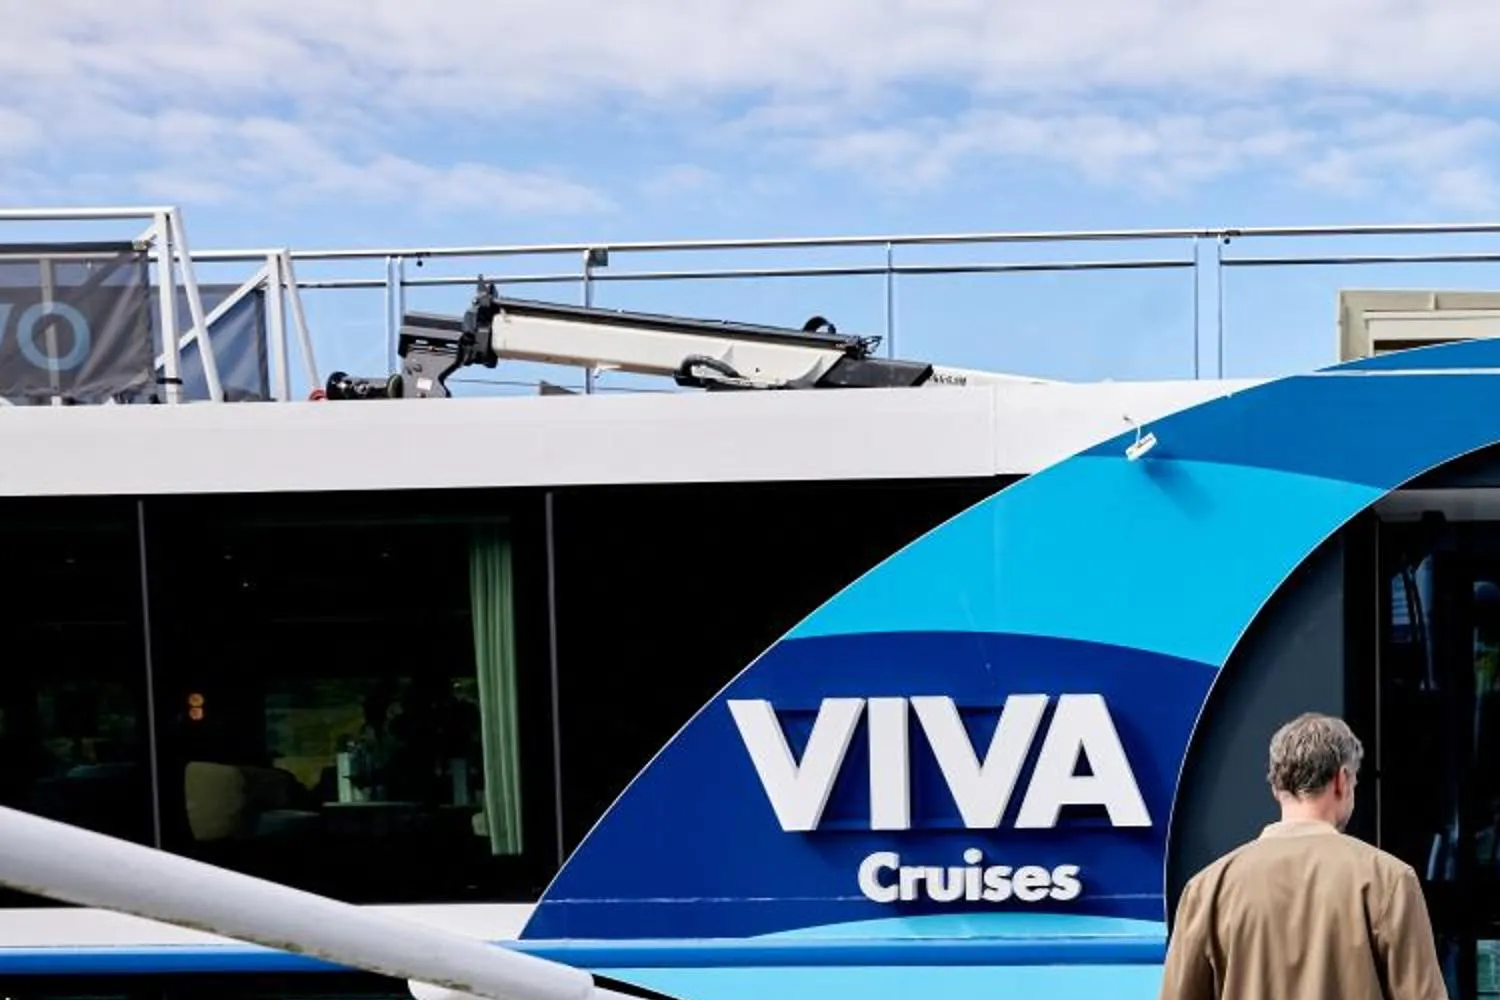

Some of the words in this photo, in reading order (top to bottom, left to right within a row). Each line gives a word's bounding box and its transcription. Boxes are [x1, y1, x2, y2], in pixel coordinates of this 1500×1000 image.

[0, 301, 91, 371] O
[727, 693, 1153, 831] VIVA
[857, 848, 1081, 903] Cruises
